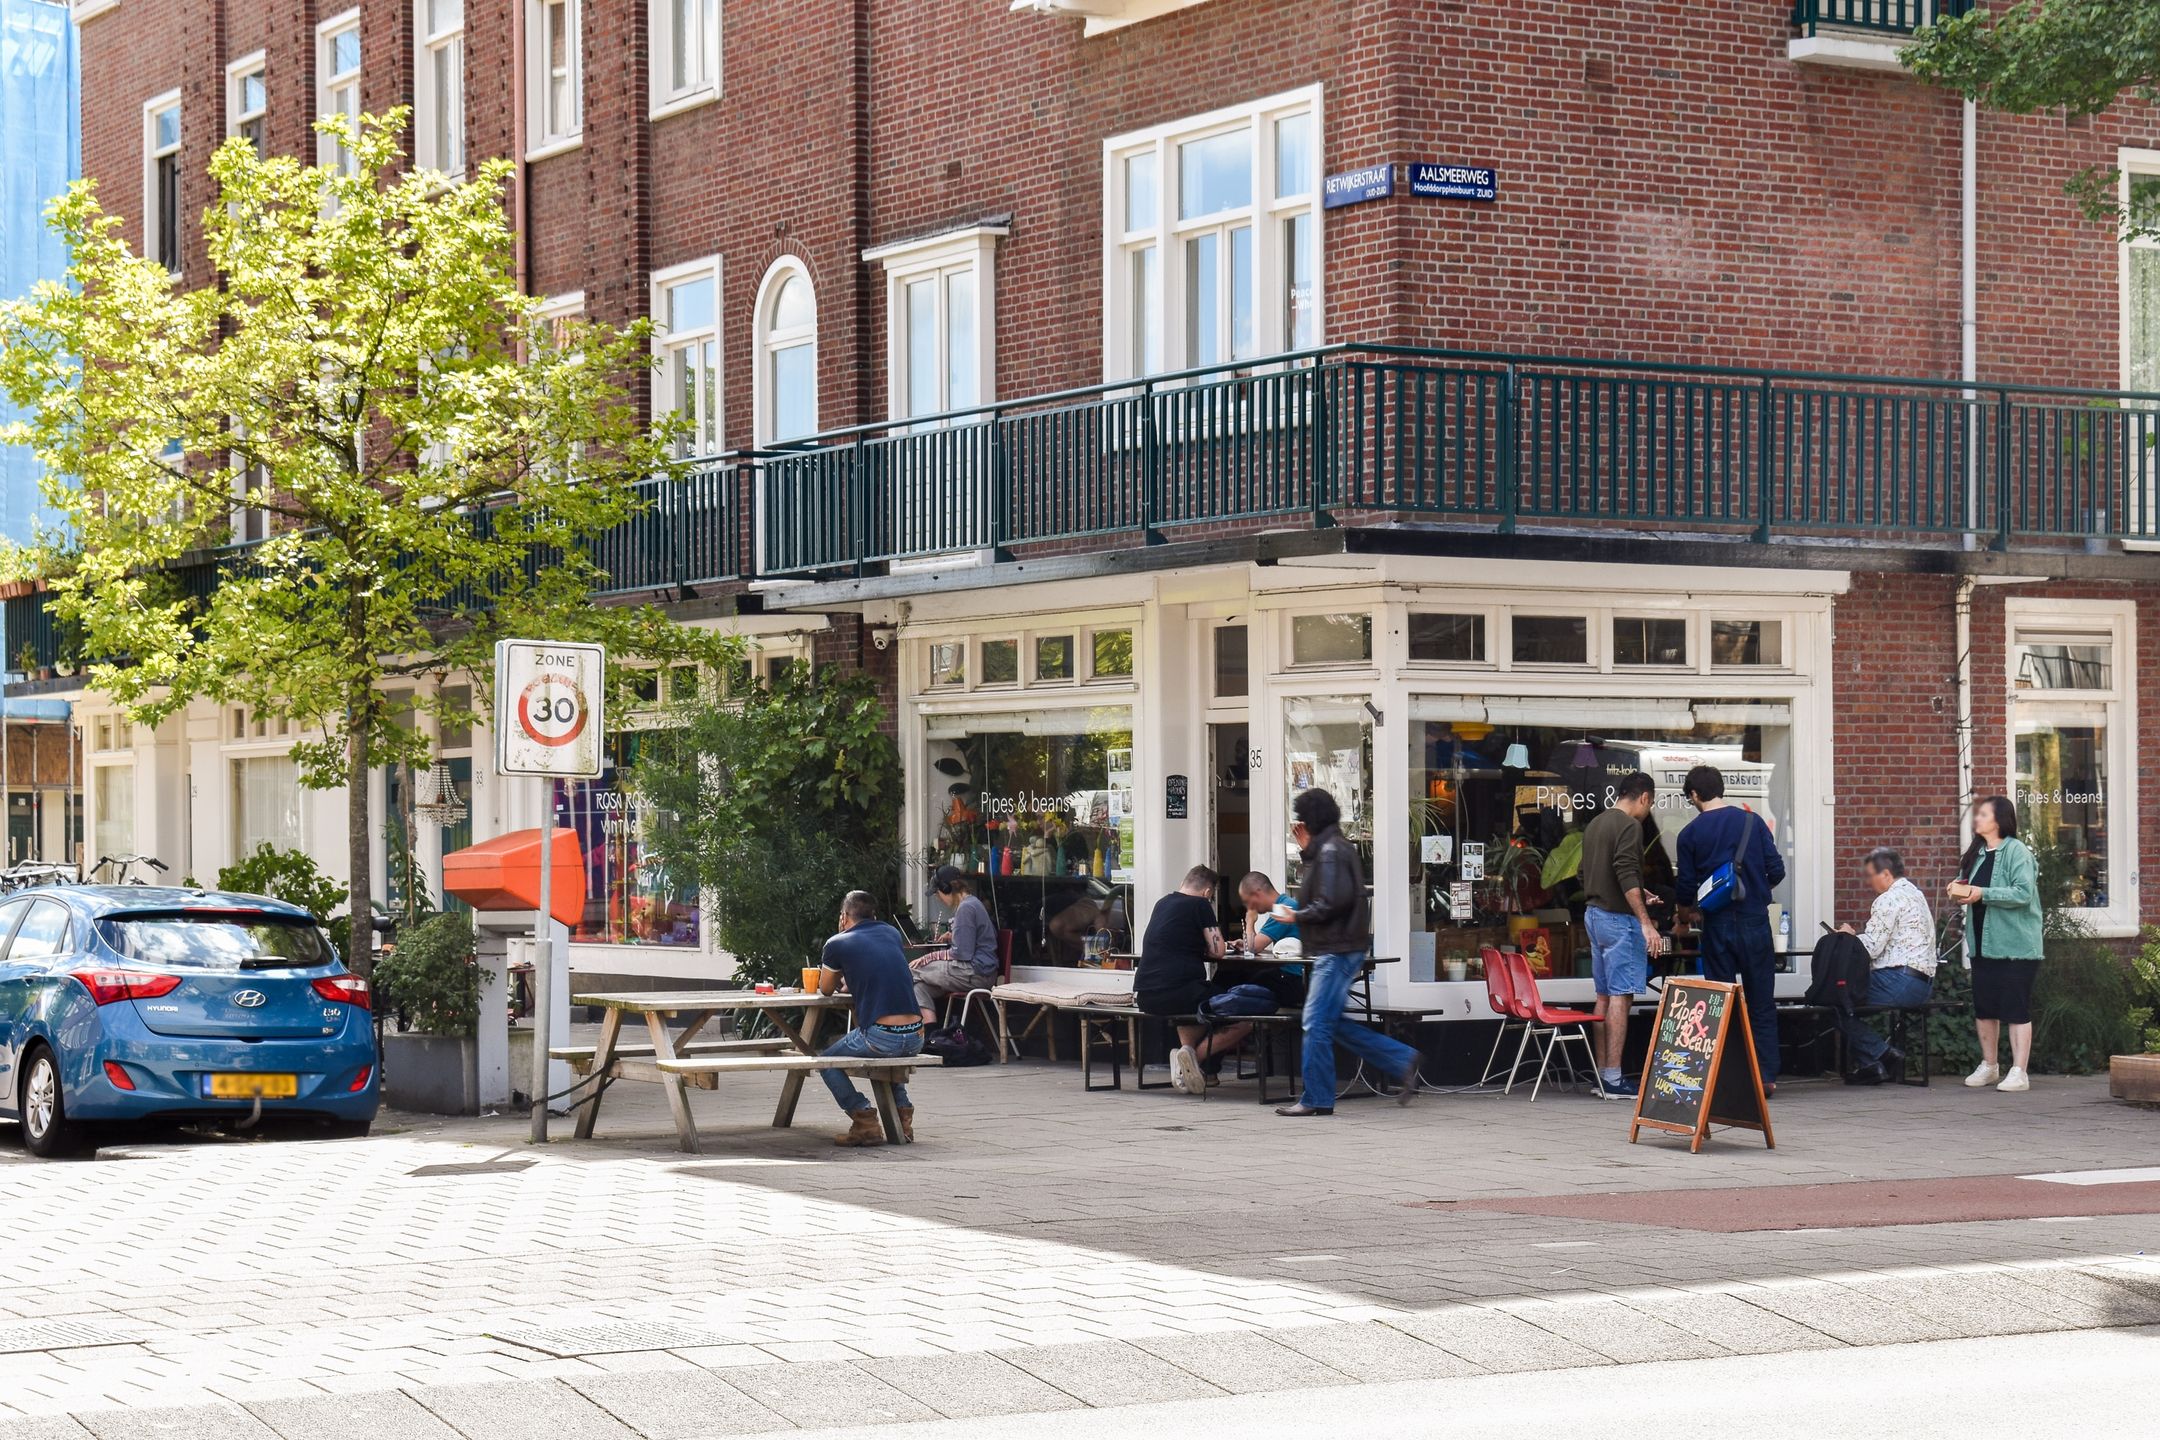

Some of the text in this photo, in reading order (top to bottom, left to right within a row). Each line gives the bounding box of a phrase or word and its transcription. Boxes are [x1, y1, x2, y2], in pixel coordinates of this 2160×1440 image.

[1326, 167, 1387, 194] RIETWIJKERSTRAAT
[1419, 166, 1489, 185] AALSMEERWEG
[1365, 185, 1387, 198] OUD-ZUID
[1414, 182, 1493, 198] Hoofddorppleinbuurt ZUID
[535, 654, 575, 667] ZONE
[533, 697, 575, 723] 30
[1250, 749, 1262, 768] 35
[596, 792, 622, 816] ROSA
[981, 790, 1070, 819] Pipes & beans
[1536, 785, 1596, 816] Pipes
[1603, 785, 1619, 810] &
[2017, 788, 2102, 808] Pipes & beans
[601, 819, 637, 834] VINTAG
[1669, 988, 1704, 1032] Pipes
[1674, 1021, 1717, 1059] Beans
